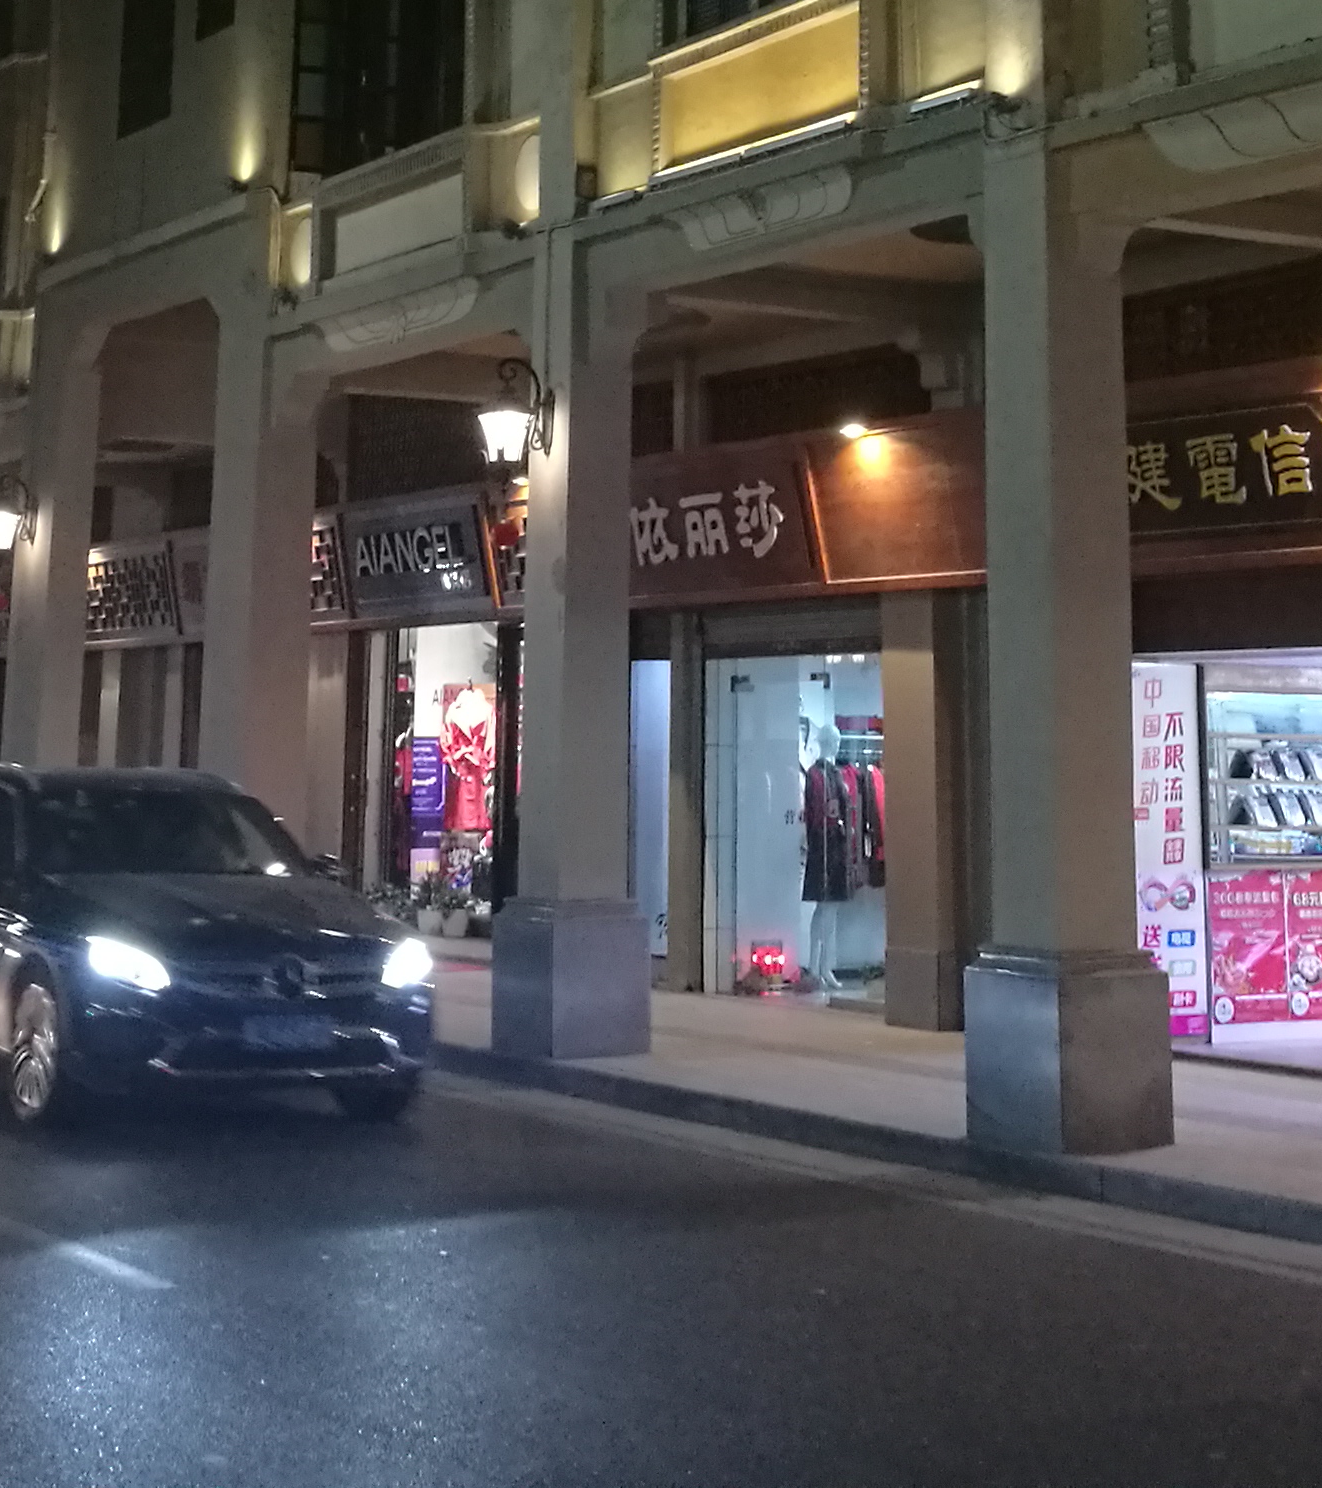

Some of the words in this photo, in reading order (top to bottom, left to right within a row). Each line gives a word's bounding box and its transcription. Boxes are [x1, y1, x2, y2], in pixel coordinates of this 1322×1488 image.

[356, 524, 464, 577] AIANGEL
[1140, 677, 1162, 807] 中国移动
[1163, 712, 1185, 833] 不限流量
